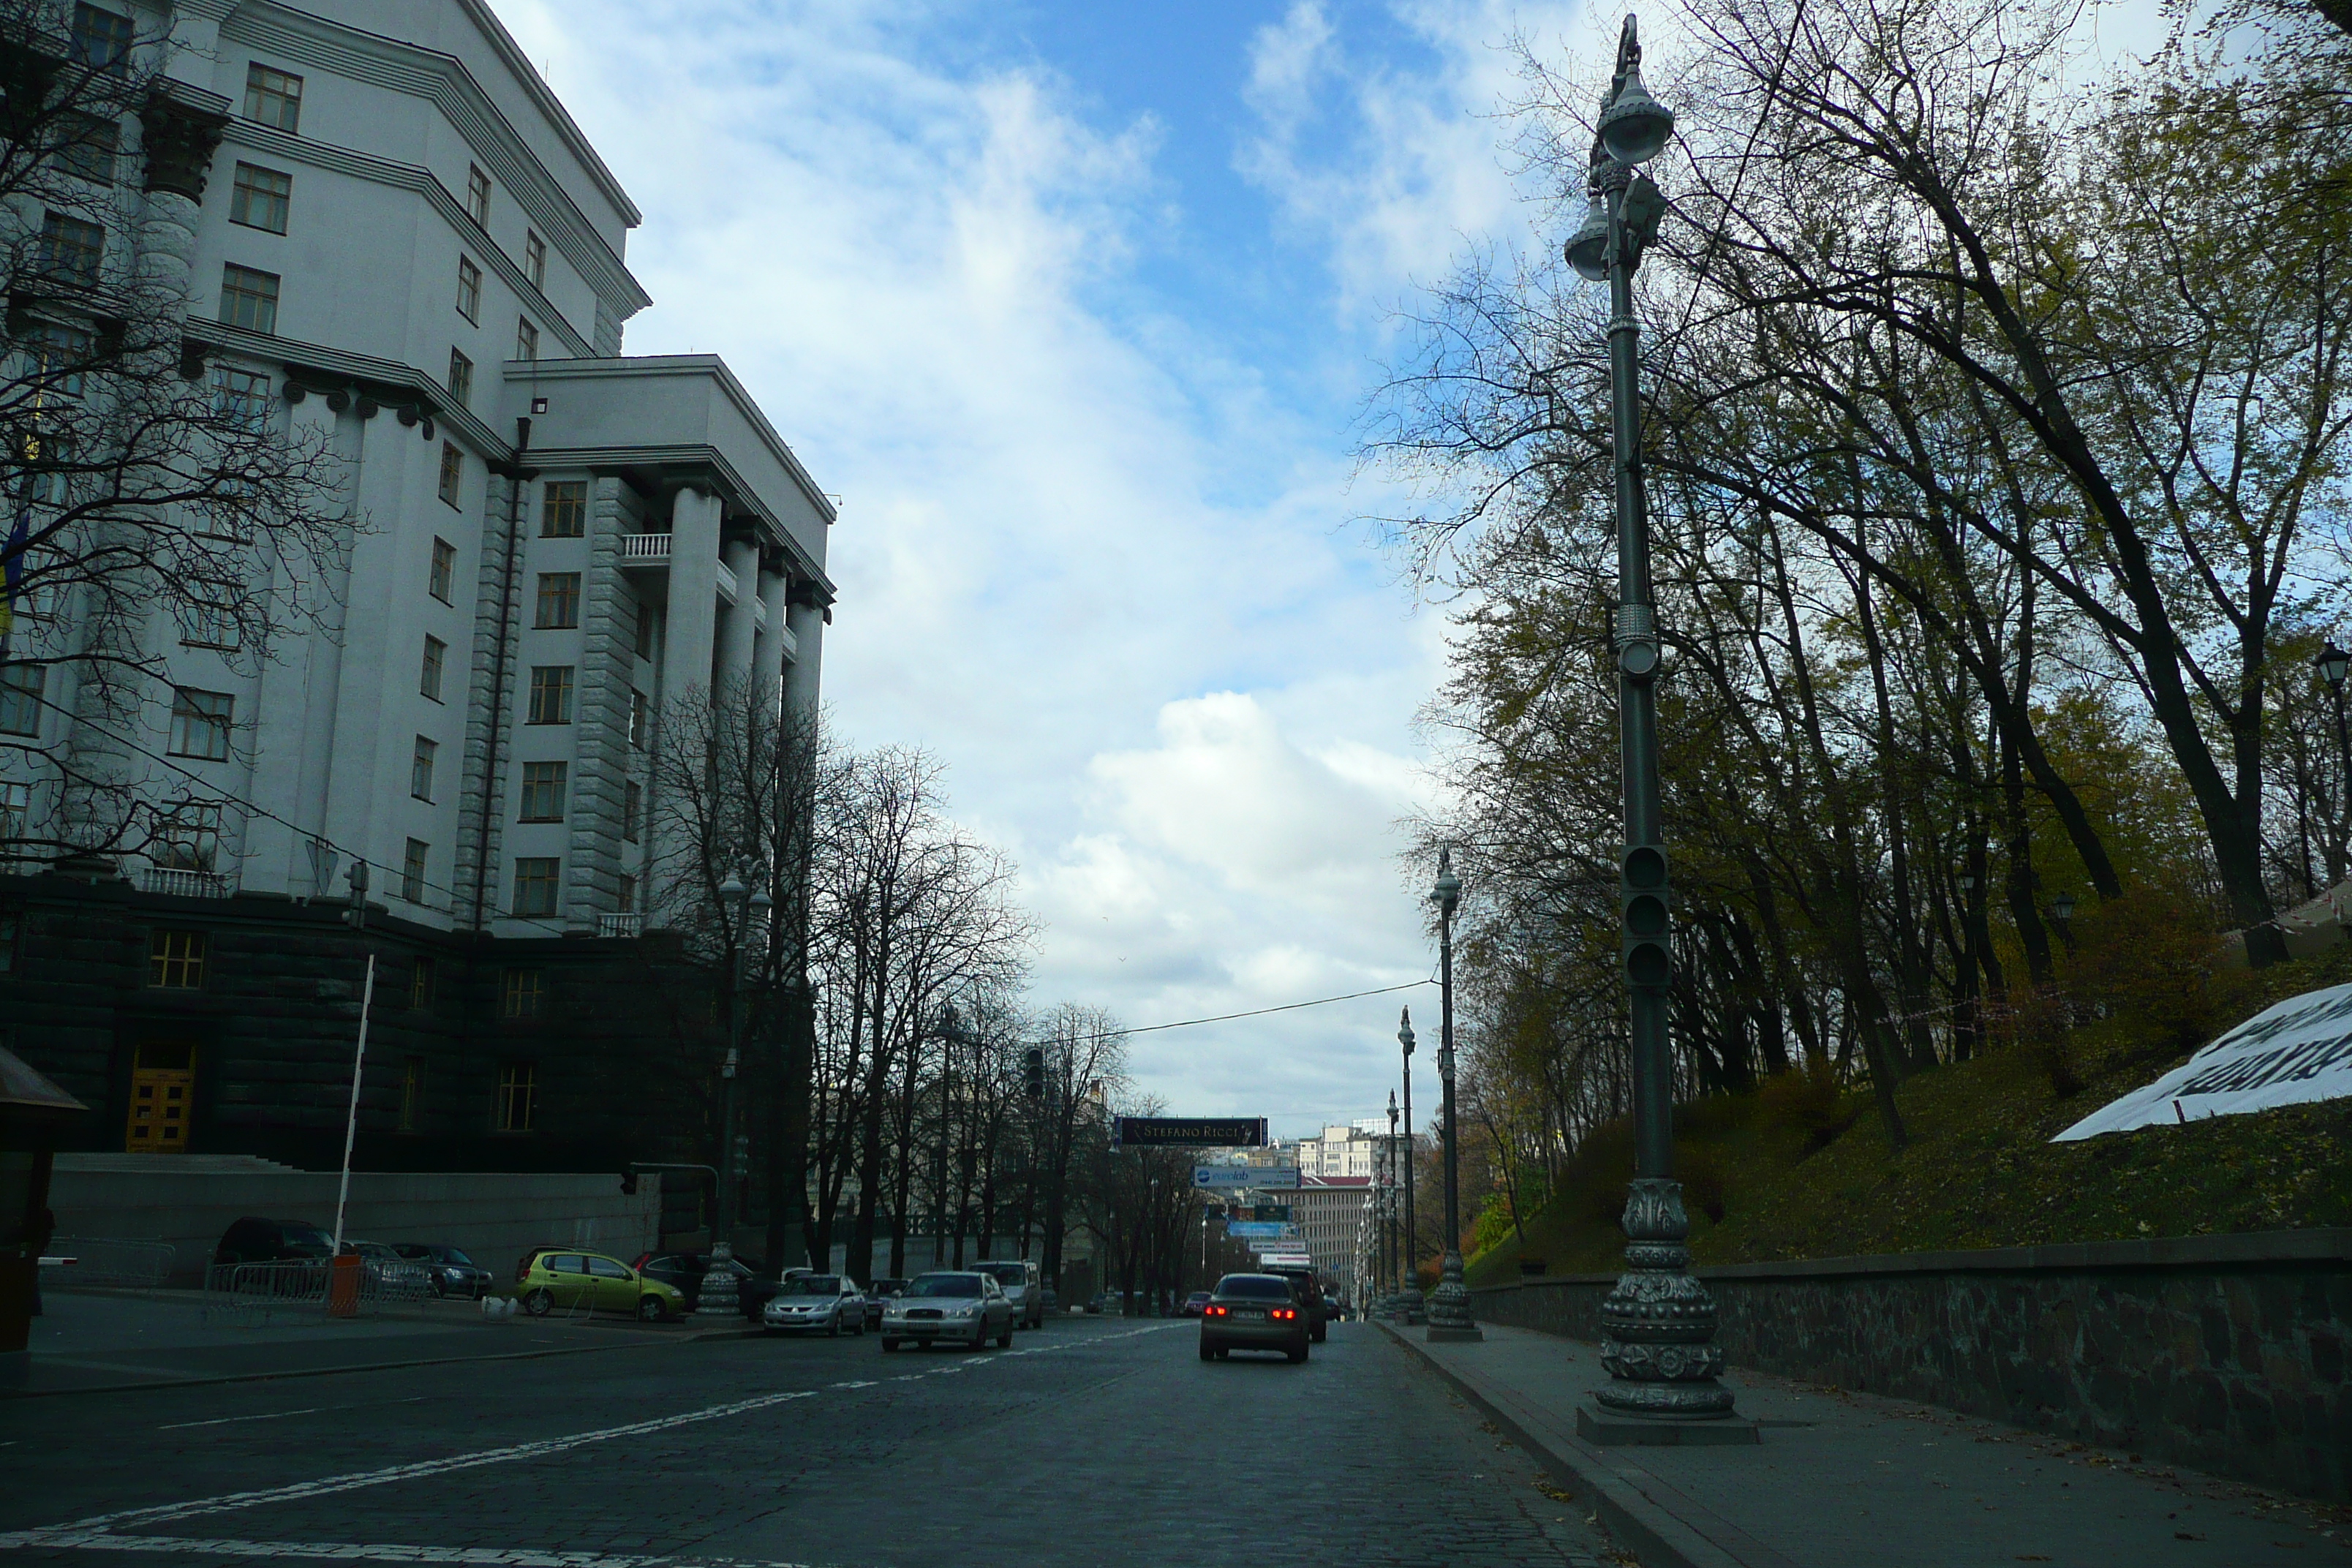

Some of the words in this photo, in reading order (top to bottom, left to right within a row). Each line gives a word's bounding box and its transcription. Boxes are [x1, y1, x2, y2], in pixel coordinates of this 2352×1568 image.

[1144, 1125, 1199, 1137] STEFANO
[1204, 1125, 1237, 1137] RICCI
[1212, 1171, 1248, 1181] eurolab
